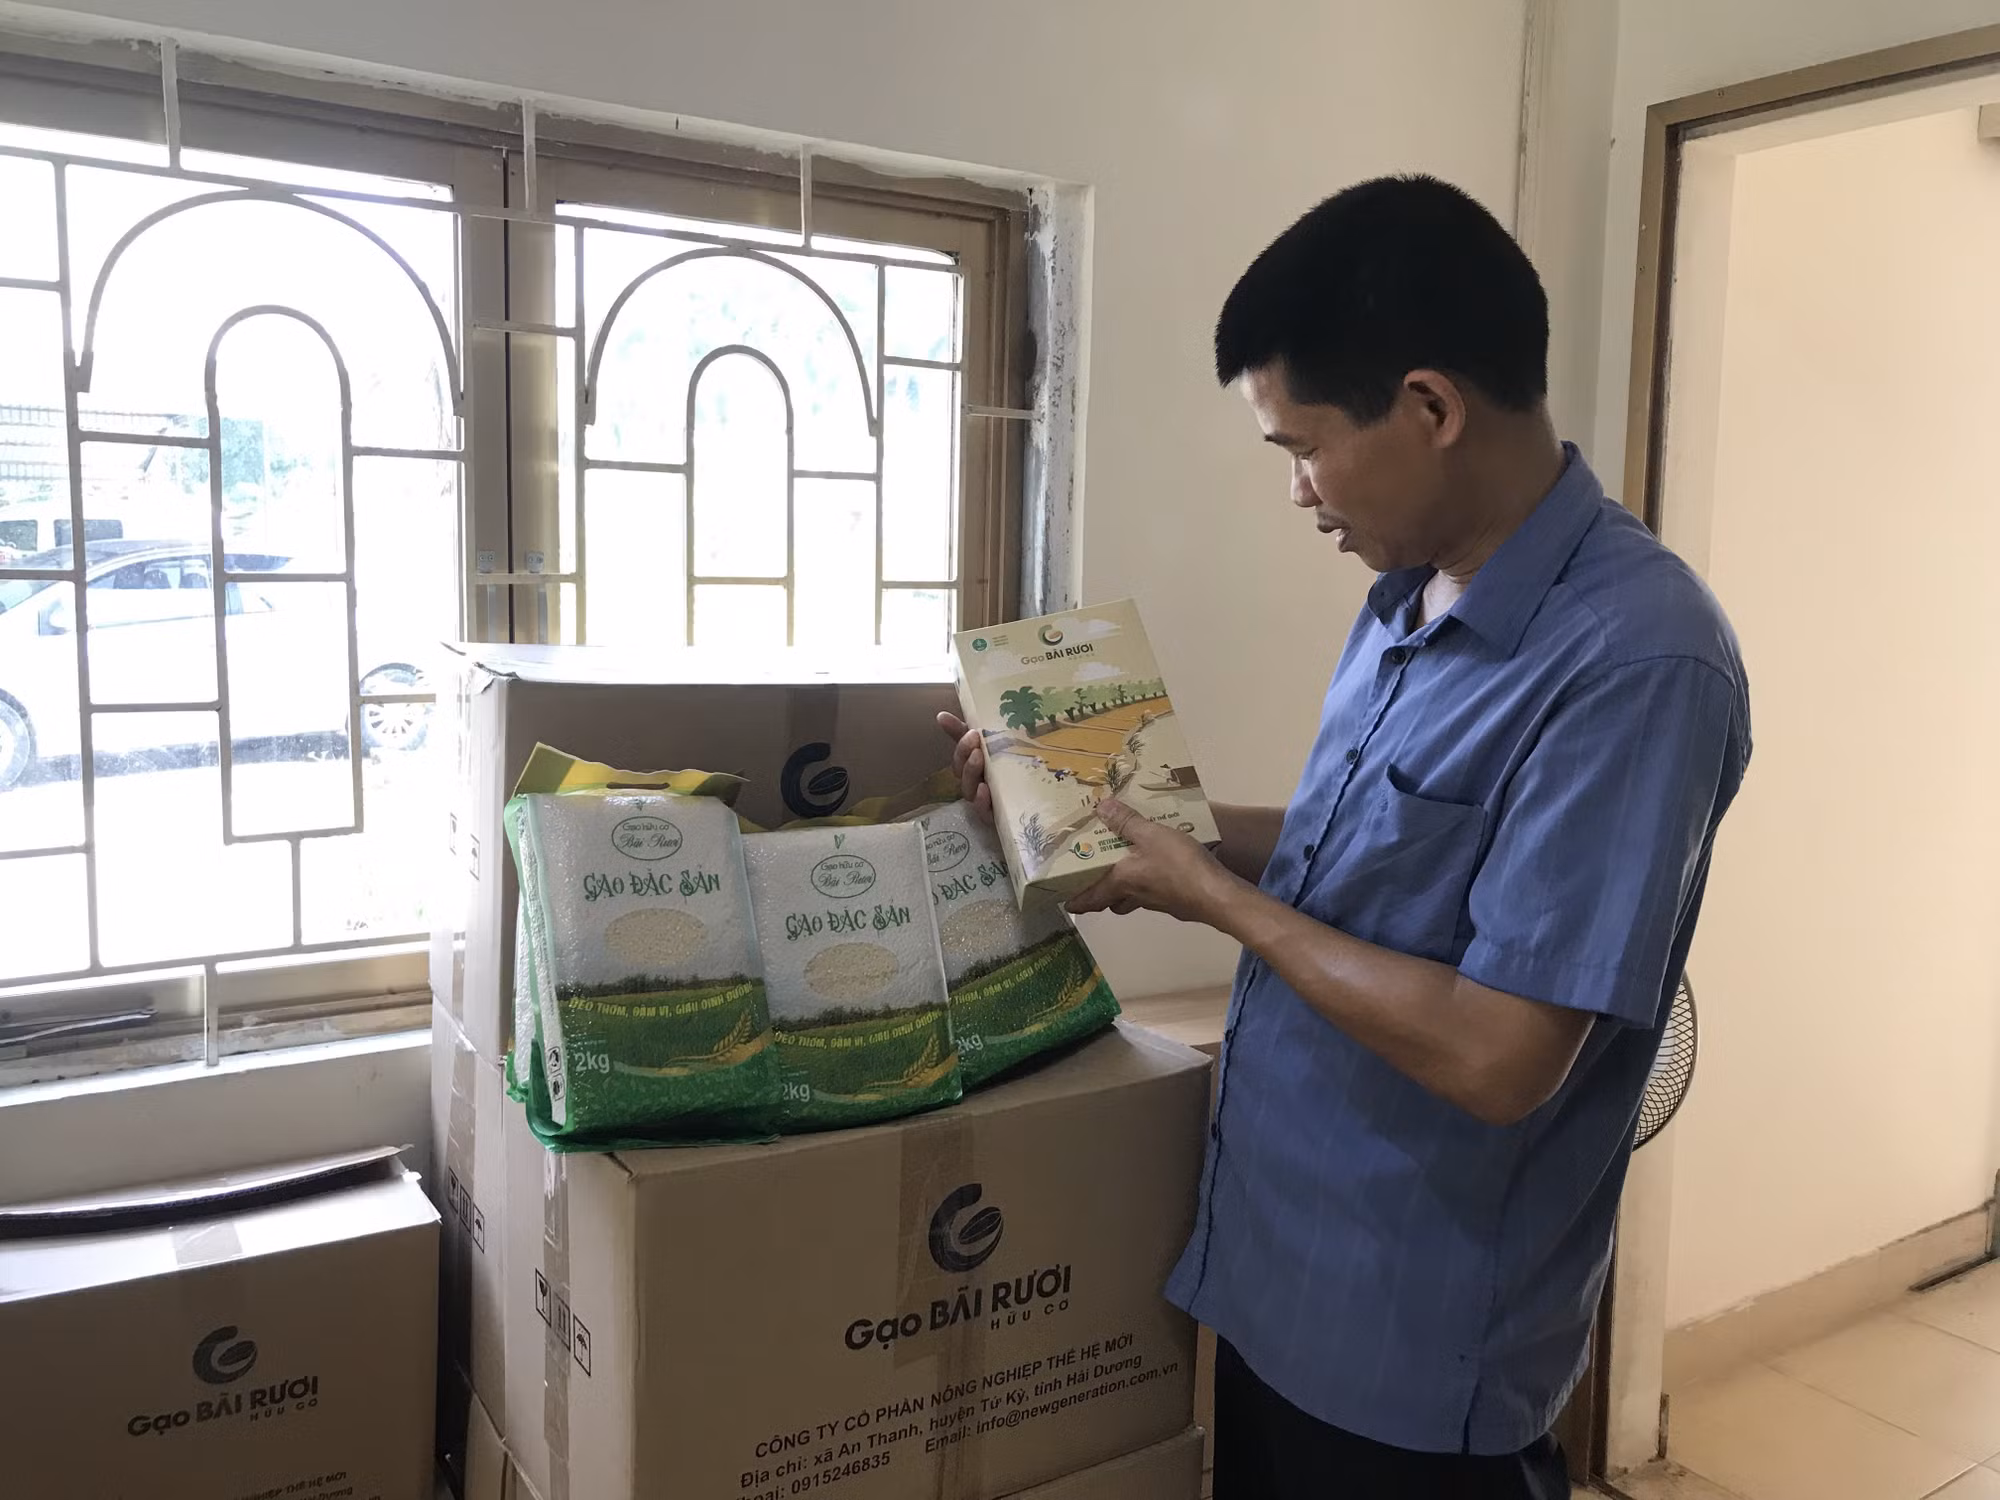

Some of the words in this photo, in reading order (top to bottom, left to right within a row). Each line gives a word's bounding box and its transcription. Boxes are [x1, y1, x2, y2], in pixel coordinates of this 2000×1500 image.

[1021, 655, 1044, 665] Gạo
[1065, 643, 1094, 657] RƯƠI
[584, 872, 625, 902] GẠO
[629, 867, 672, 897] ĐẶC
[679, 865, 721, 902] SẢN
[786, 913, 823, 941] GẠO
[827, 906, 867, 933] ĐẶC
[872, 899, 911, 934] SẢN
[573, 1051, 610, 1074] 2kg
[844, 1312, 923, 1350] Gạo
[929, 1285, 983, 1332] BÃI
[991, 1264, 1072, 1313] RƯƠI
[990, 1310, 1031, 1331] HỮU
[1044, 1300, 1070, 1316] CƠ
[128, 1410, 191, 1436] Gạo
[196, 1392, 243, 1423] BÃI
[250, 1375, 319, 1410] RƯƠI
[755, 1430, 811, 1458] CÔNG
[816, 1420, 840, 1440] TY
[844, 1409, 870, 1431] CỔ
[876, 1394, 925, 1423] PHẦN
[930, 1379, 977, 1407] NÔNG
[982, 1360, 1043, 1390] NGHIỆP
[1046, 1349, 1076, 1371] THẾ
[1080, 1343, 1101, 1361] HỆ
[1104, 1333, 1134, 1354] MỚI
[740, 1470, 770, 1488] Địa
[776, 1455, 808, 1478] chỉ:
[813, 1447, 834, 1466] xã
[838, 1442, 861, 1458] An
[866, 1423, 924, 1448] Thanh,
[929, 1407, 975, 1431] huyện
[981, 1395, 1002, 1412] Tứ
[1006, 1387, 1030, 1407] Kỳ,
[1034, 1378, 1063, 1398] tỉnh
[1066, 1368, 1089, 1387] Hải
[1094, 1355, 1143, 1379] Dương
[791, 1450, 891, 1495] 0915246835
[925, 1427, 971, 1453] Email:
[976, 1361, 1179, 1435] info@newgeneration.com.vn
